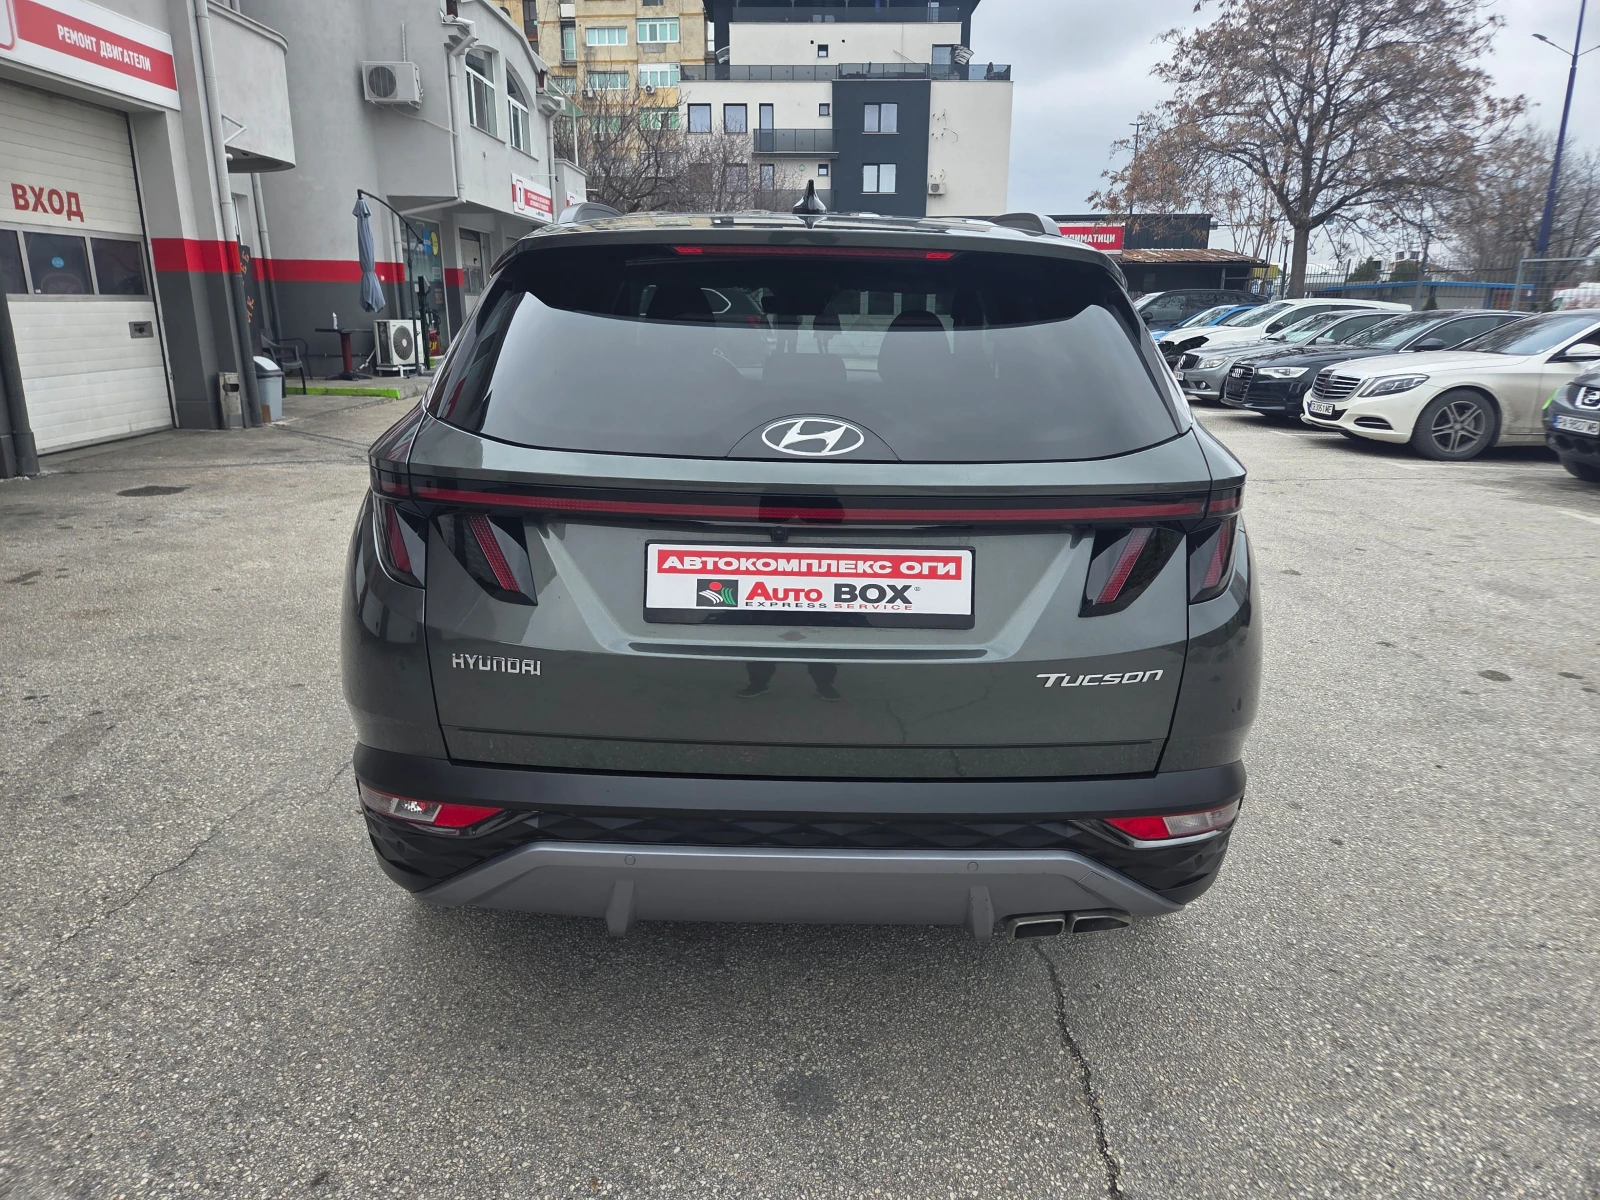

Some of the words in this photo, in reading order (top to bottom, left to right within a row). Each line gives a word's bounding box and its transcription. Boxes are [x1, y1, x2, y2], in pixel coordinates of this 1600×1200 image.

[57, 24, 97, 53] РЕМОНТ
[100, 40, 152, 72] ДВИГАТЕЛИ
[10, 182, 85, 223] ВХОД
[661, 556, 893, 574] АВТОКОМПЛЕКС
[899, 561, 956, 576] ОГИ
[745, 581, 823, 603] AUTO
[745, 601, 827, 609] EXPRESS
[834, 603, 913, 611] SERVICE
[452, 653, 541, 676] HYUNDAI
[1036, 669, 1164, 688] TUCSON
